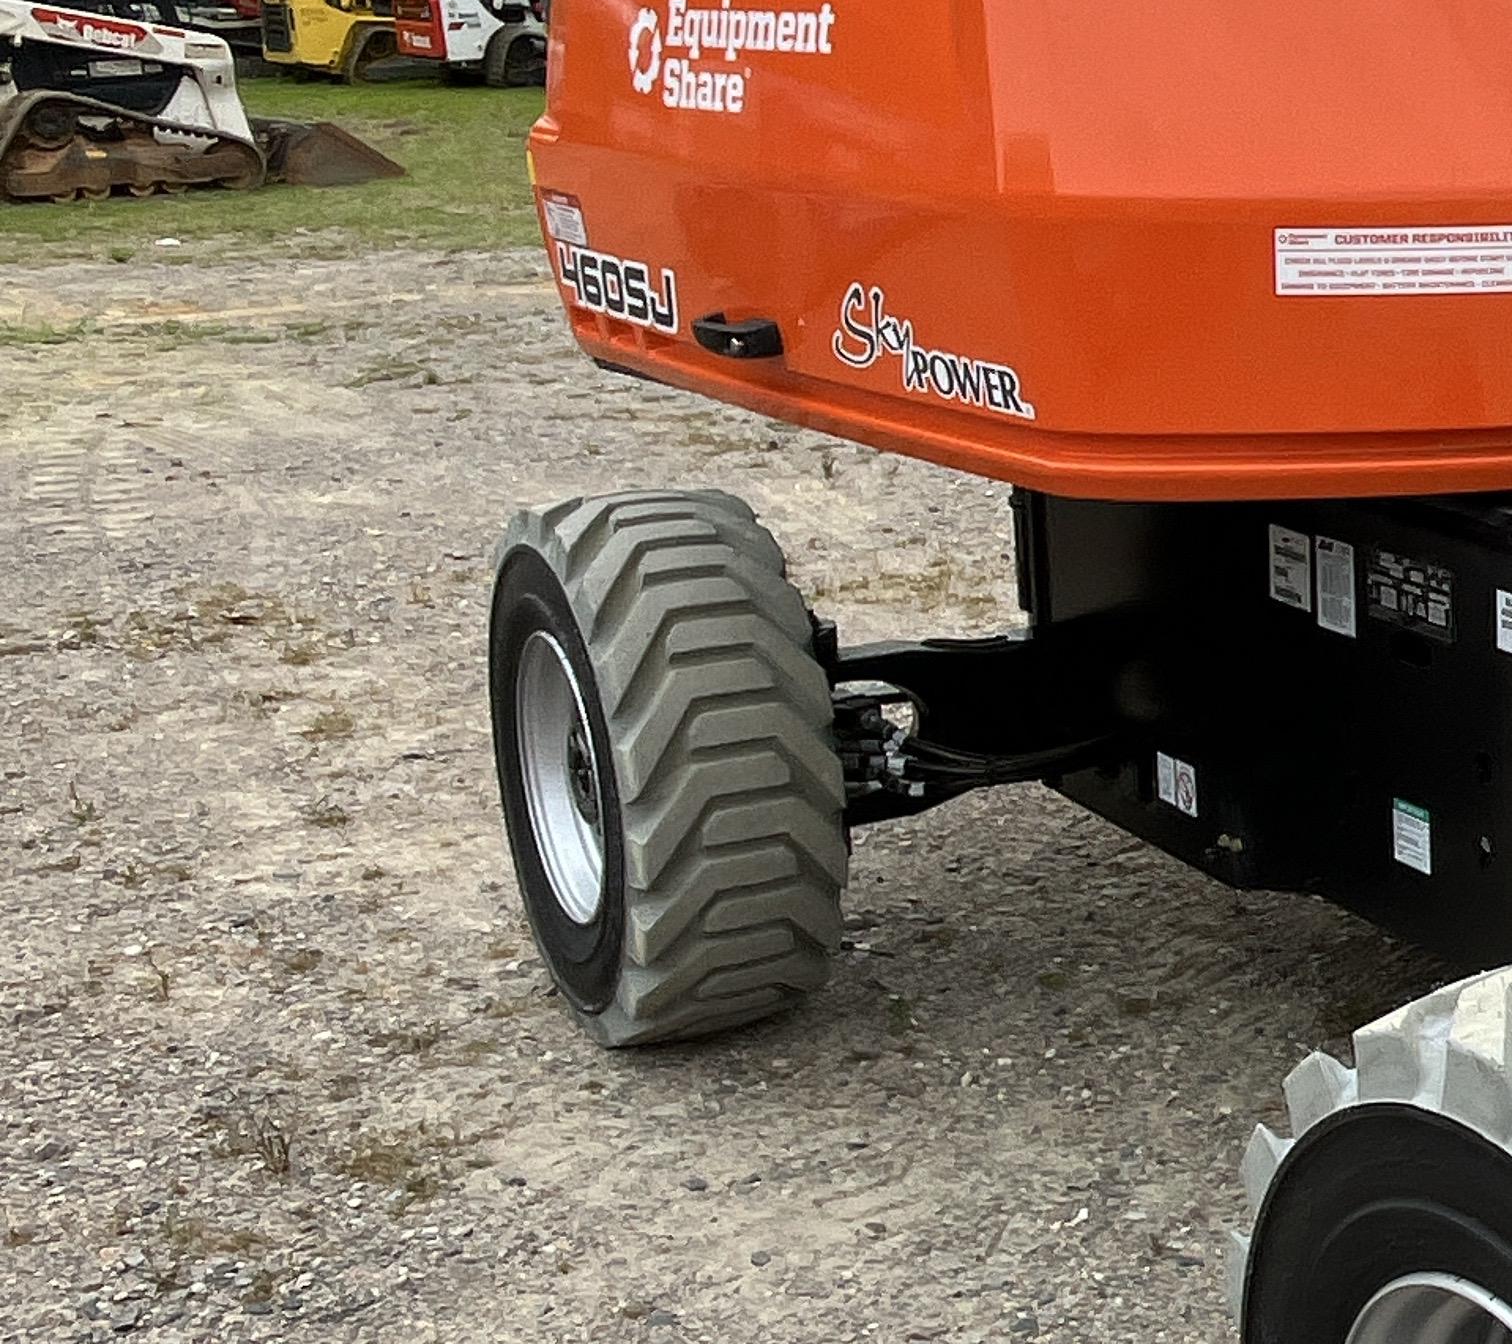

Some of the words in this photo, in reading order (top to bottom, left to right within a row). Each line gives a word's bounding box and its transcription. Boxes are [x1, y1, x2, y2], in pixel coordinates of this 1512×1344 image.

[83, 24, 136, 48] Bobcat
[662, 58, 745, 113] Share
[1334, 232, 1408, 245] CUSTOMER
[557, 243, 677, 331] 460SJ
